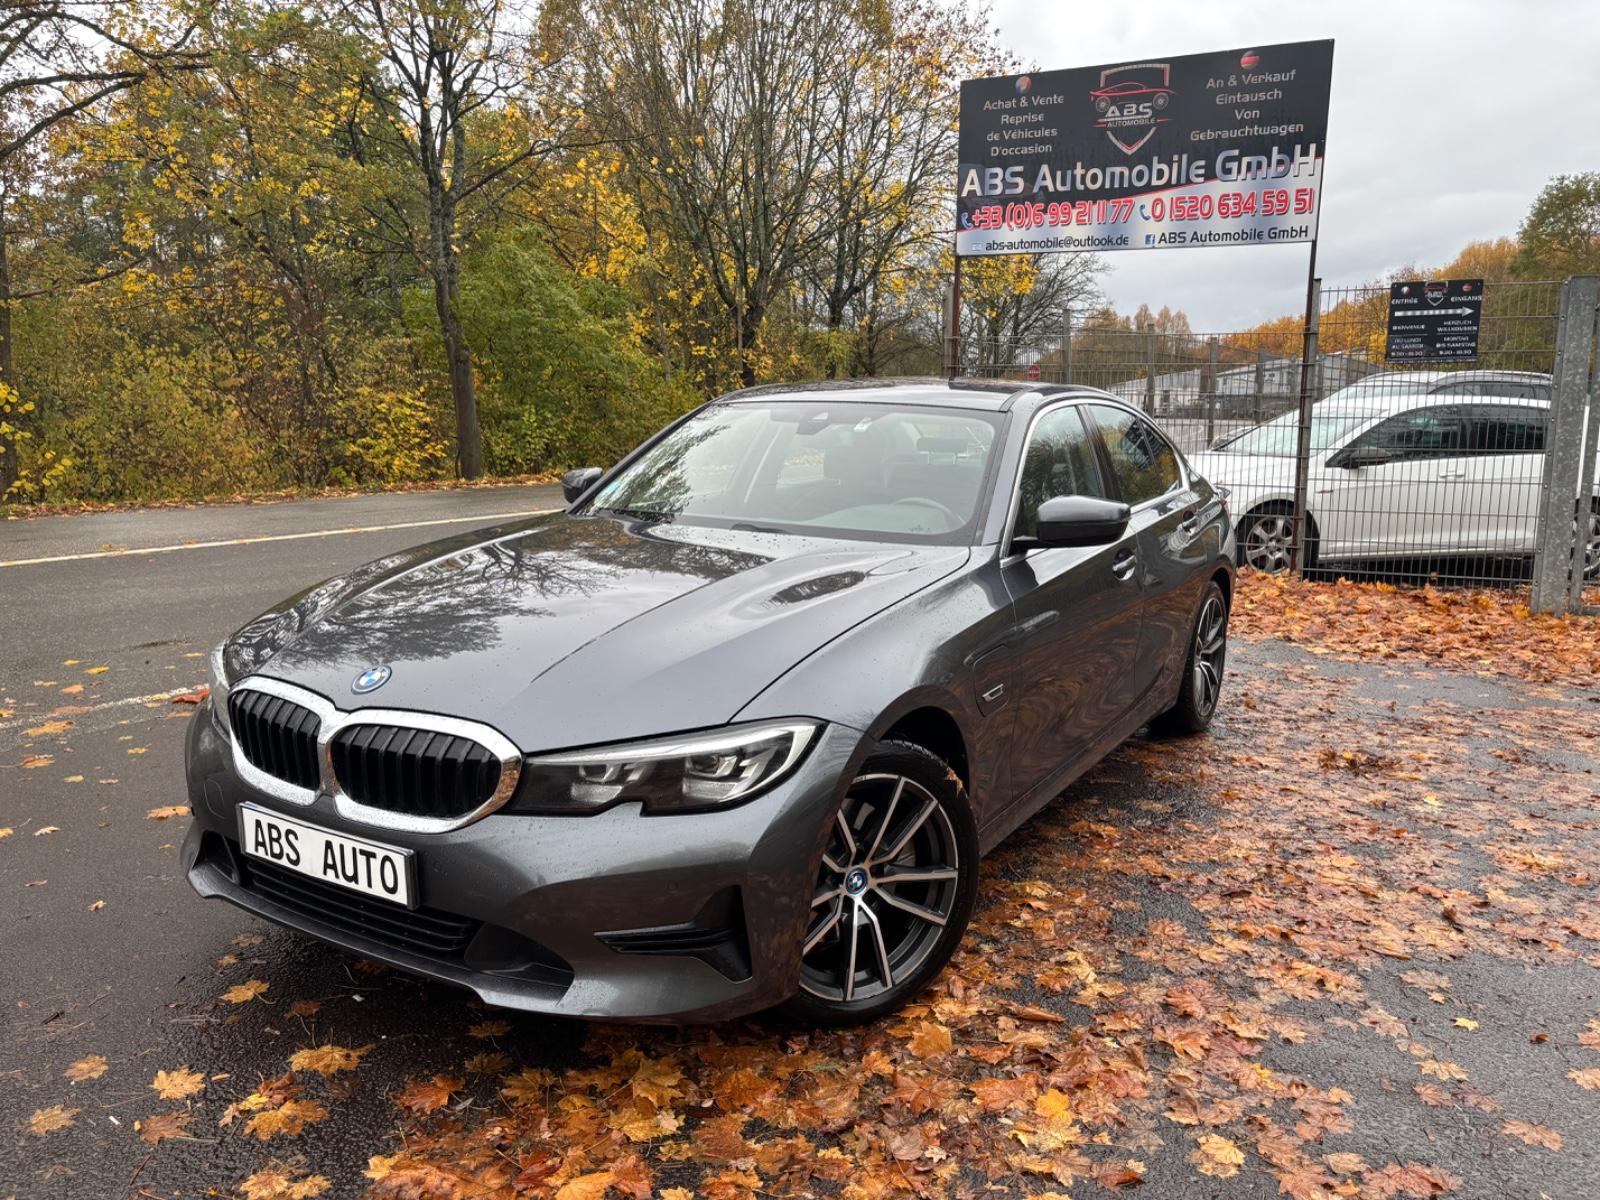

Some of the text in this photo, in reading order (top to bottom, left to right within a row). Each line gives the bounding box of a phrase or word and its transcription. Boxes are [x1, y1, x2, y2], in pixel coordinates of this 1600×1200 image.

[1206, 69, 1296, 89] An & Verkauf
[983, 93, 1064, 111] Achat & Vente
[1216, 88, 1282, 105] Eintausch
[1105, 102, 1152, 118] ABS
[1235, 109, 1260, 120] Von
[1001, 112, 1045, 127] Reprise
[1107, 118, 1156, 128] AUTOMOBILE
[987, 126, 1058, 141] de Véhicules
[1190, 123, 1304, 141] Gebrauchtwagen
[991, 143, 1052, 157] D'occasion
[961, 143, 1316, 197] ABS Automobile GmbH
[1217, 190, 1257, 219] 634
[1261, 189, 1290, 216] 59
[1294, 187, 1315, 214] 51
[972, 205, 1003, 230] +33
[1110, 198, 1136, 223] 77
[1158, 225, 1308, 244] ABS Automobile GmbH
[985, 235, 1129, 252] abs-automobile@outlook.de
[255, 819, 398, 895] ABS AUTO
